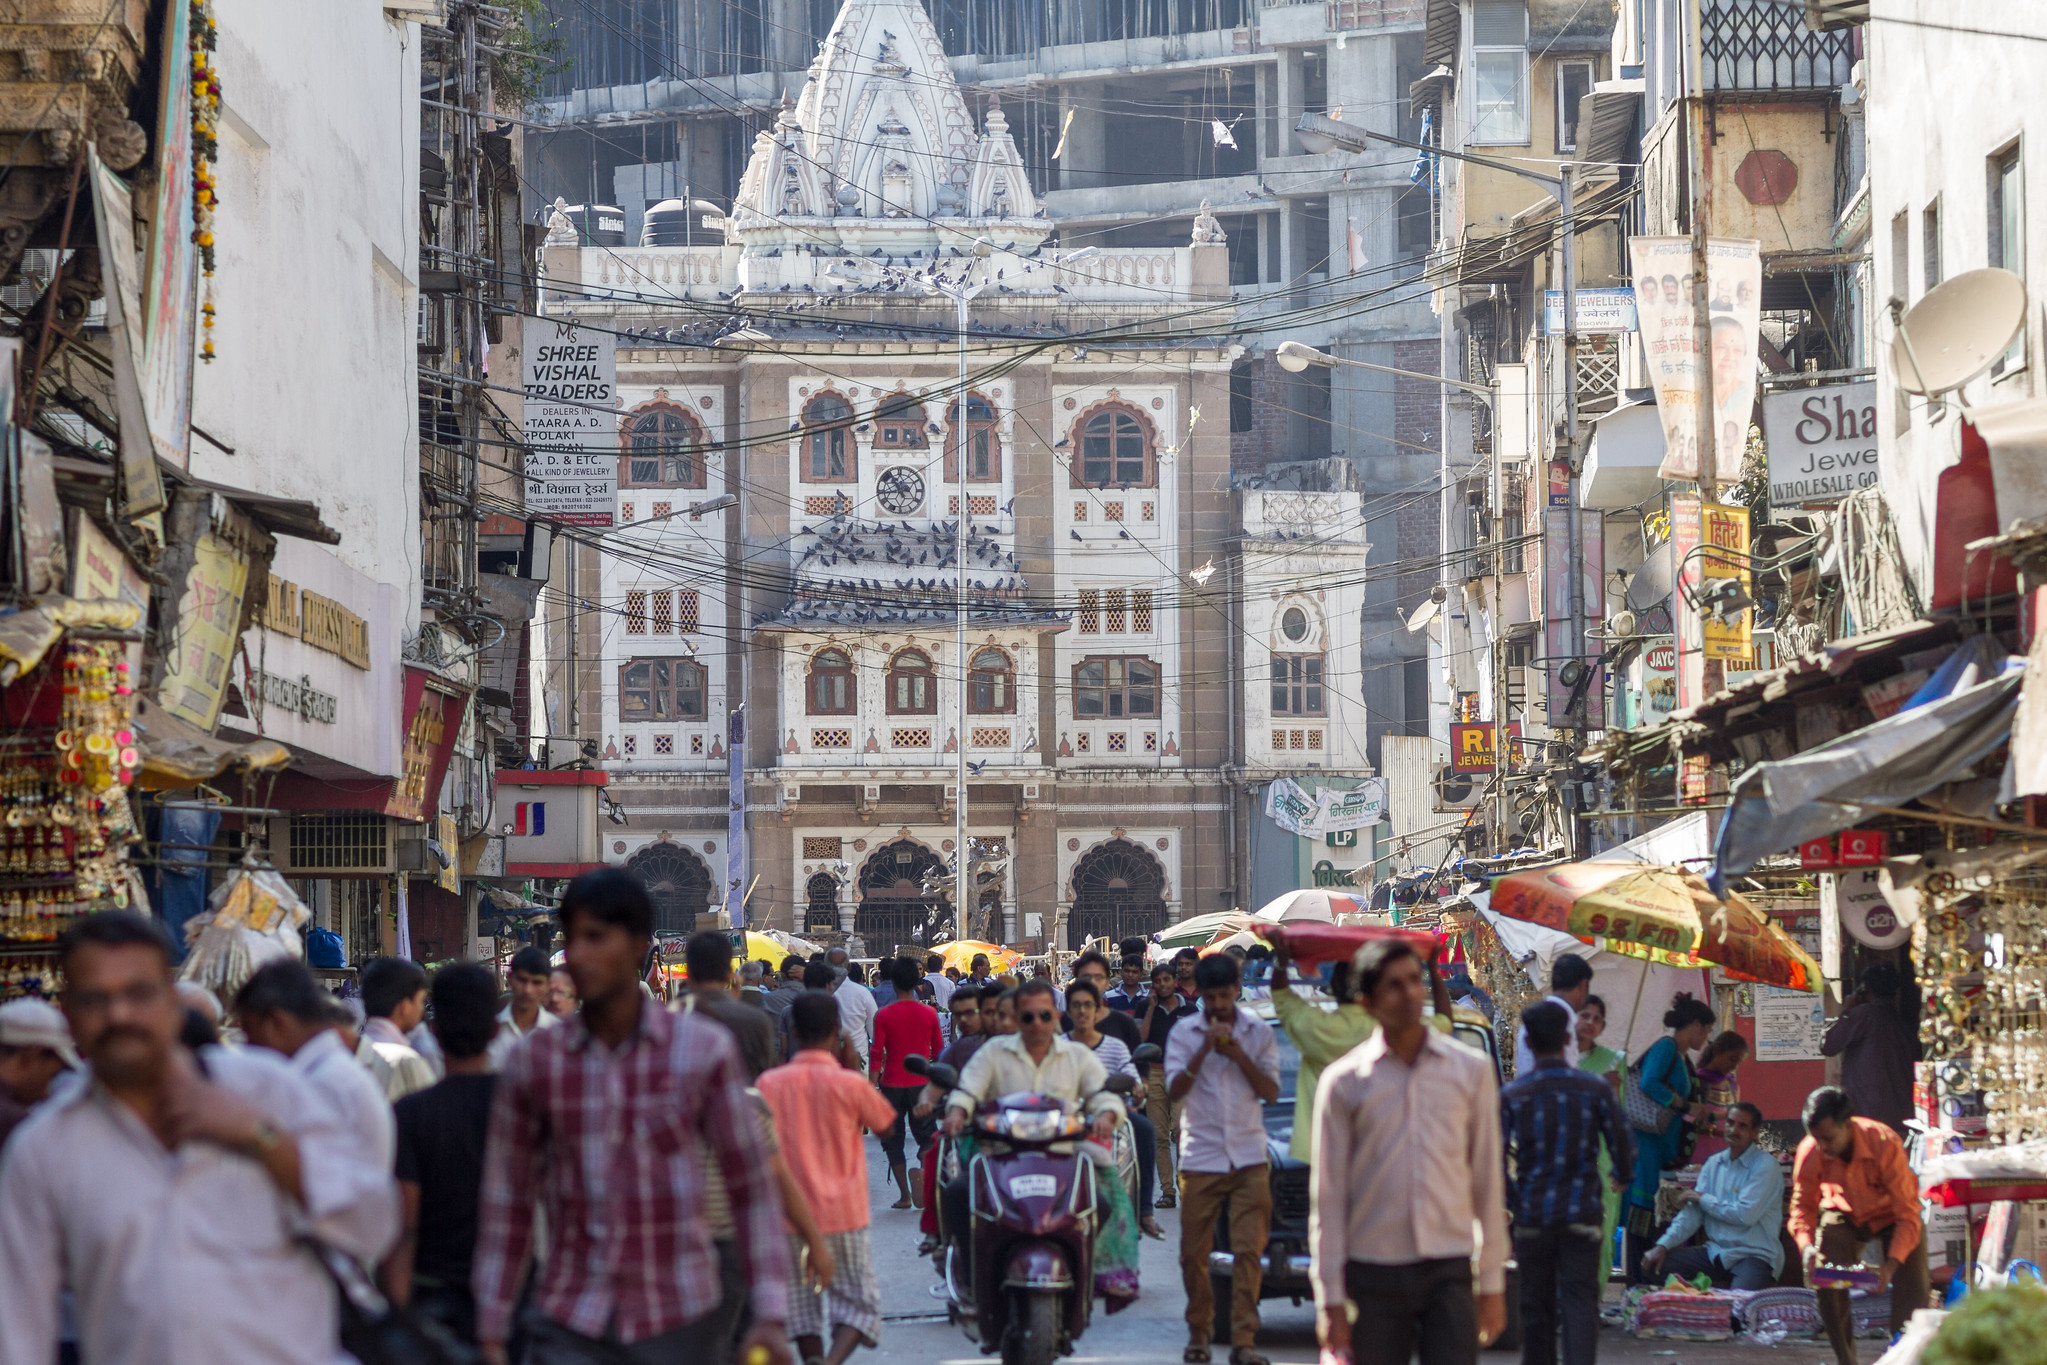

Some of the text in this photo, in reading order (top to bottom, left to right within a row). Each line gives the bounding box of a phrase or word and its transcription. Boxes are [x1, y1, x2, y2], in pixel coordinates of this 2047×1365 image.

[1545, 297, 1564, 307] DEE
[537, 345, 599, 362] SHREE
[533, 365, 601, 381] VISHAL
[524, 384, 610, 400] TRADERS
[542, 408, 579, 416] DEALERS
[530, 418, 570, 428] TAARA
[1795, 394, 1877, 445] Sha
[531, 431, 575, 440] POLAKI
[563, 455, 572, 465] &
[576, 455, 602, 465] ETC.
[1800, 448, 1878, 473] Jewe
[545, 468, 561, 476] KIND
[562, 468, 572, 476] OF
[573, 467, 610, 476] JEWELLERY
[546, 483, 581, 495] विशाल
[584, 482, 608, 496] ट्रेडर्स
[1772, 470, 1878, 500] WHOLESALE GO
[1650, 650, 1674, 668] JAYC
[1458, 753, 1524, 767] JEWELRS
